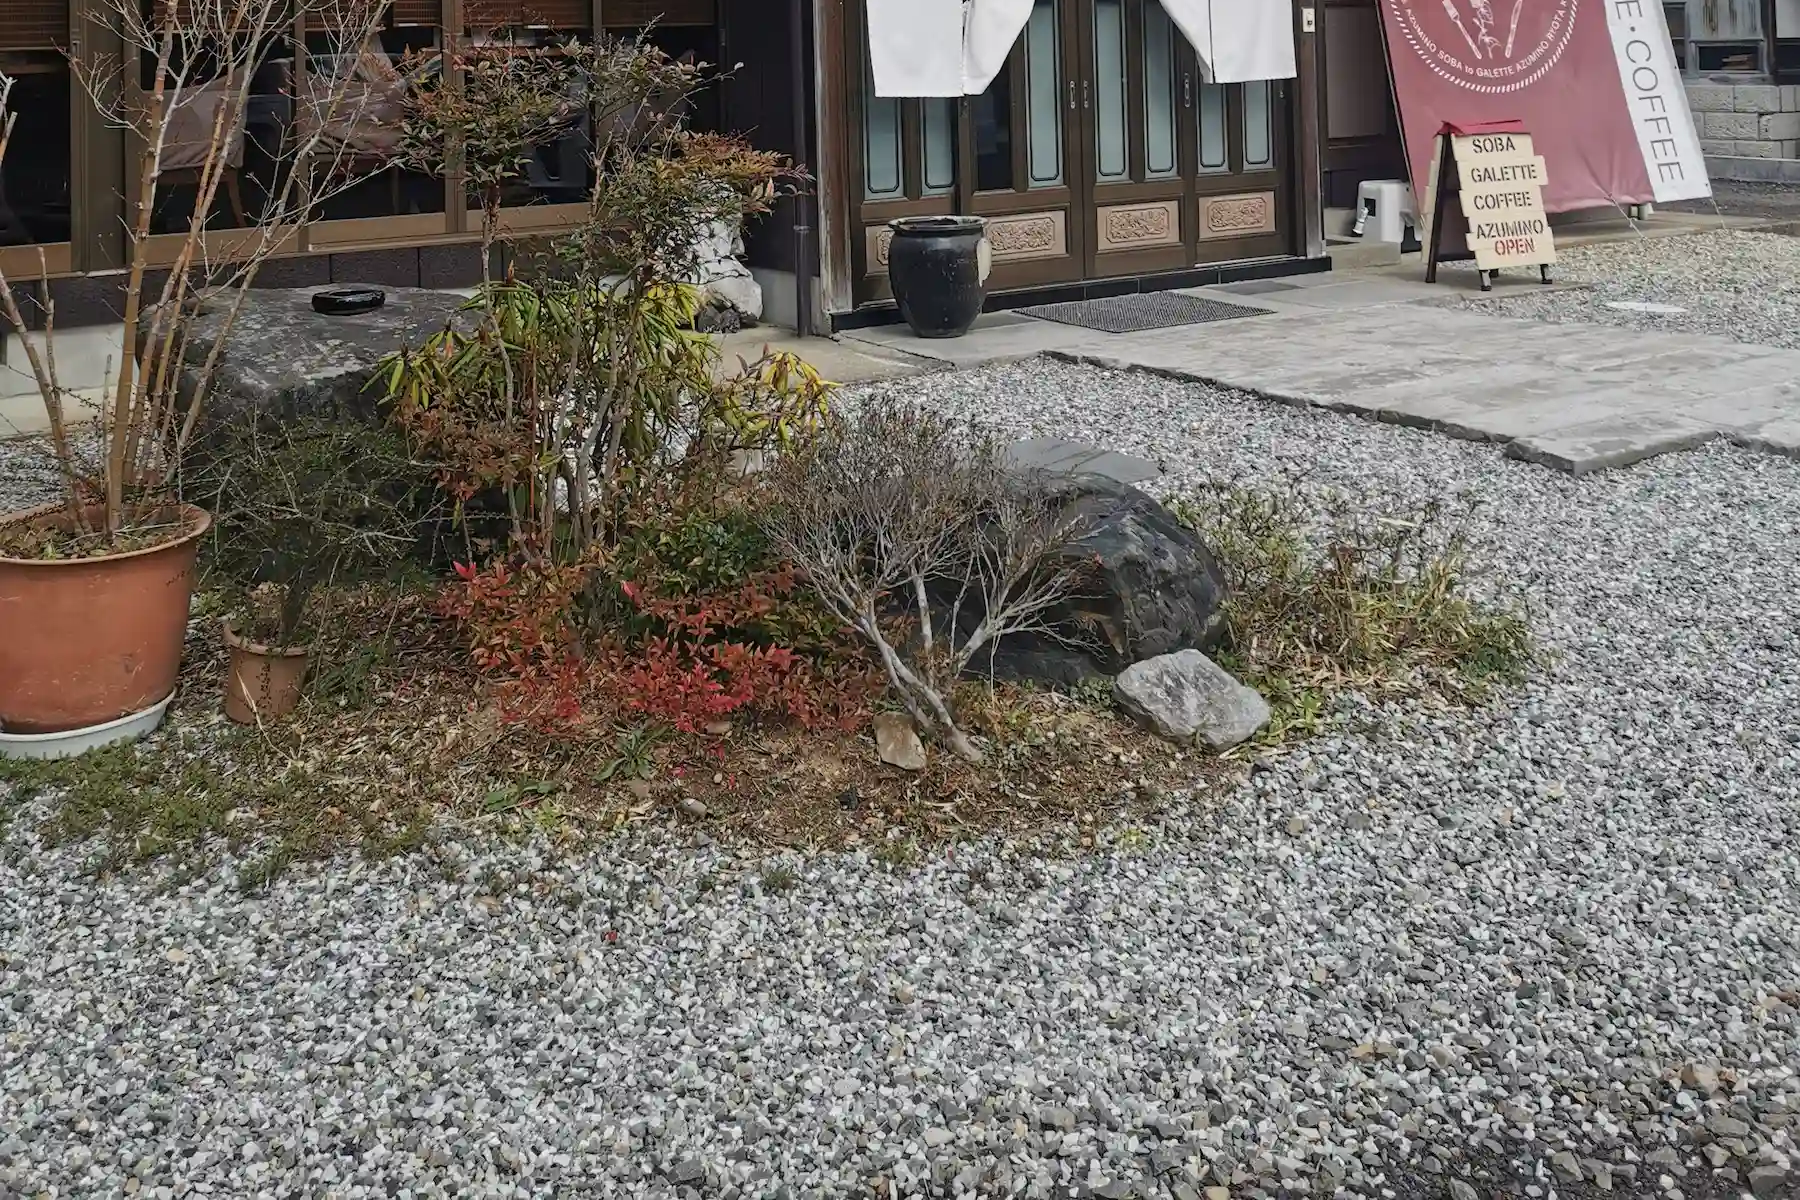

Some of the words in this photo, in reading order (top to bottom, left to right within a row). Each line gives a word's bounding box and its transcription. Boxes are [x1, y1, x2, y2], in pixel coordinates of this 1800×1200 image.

[1438, 50, 1462, 70] SOBA
[1465, 65, 1474, 75] to
[1476, 66, 1514, 78] GALETTE
[1516, 40, 1549, 73] AZUMINO
[1545, 9, 1566, 41] RYOTA
[1472, 136, 1516, 153] SOBA
[1471, 164, 1537, 183] GALETTE
[1474, 191, 1532, 210] COFFEE
[1476, 219, 1544, 239] AZUMINO
[1494, 238, 1535, 256] OPEN
